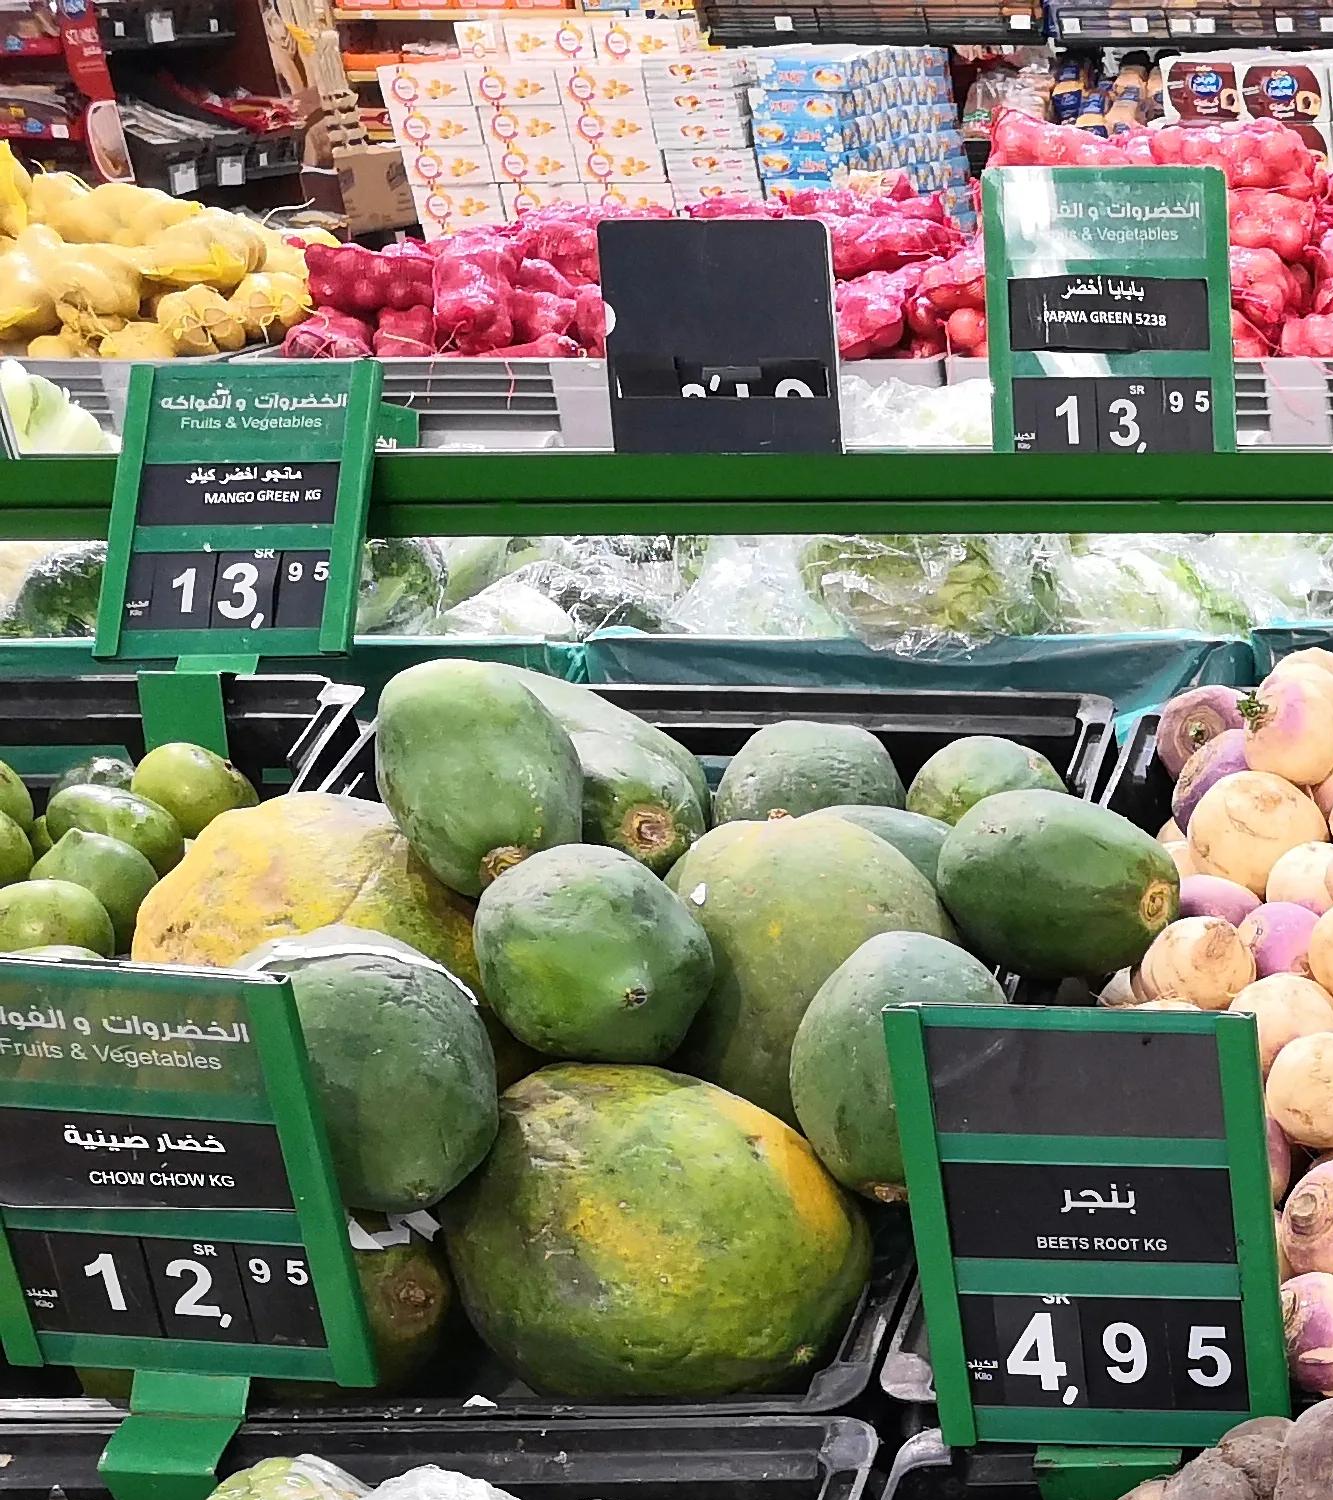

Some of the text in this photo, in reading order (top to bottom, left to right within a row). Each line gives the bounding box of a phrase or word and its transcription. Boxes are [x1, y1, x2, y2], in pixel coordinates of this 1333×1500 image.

[1082, 227, 1093, 240] &
[1096, 227, 1179, 243] Vegetables
[1044, 310, 1167, 327] PAPAYA GREEN 5238
[1129, 384, 1145, 395] SR
[254, 393, 348, 411] الخضروات
[180, 415, 322, 432] Fruits & Vegetables
[185, 467, 216, 484] كيلو
[204, 489, 321, 504] MANGO GREEN KG
[254, 548, 275, 559] SR
[0, 1005, 250, 1043] الخضروات و الفوا
[0, 1037, 223, 1071] Fruits & Vegetables
[63, 1124, 227, 1154] خضار صينية
[89, 1170, 235, 1188] CHOW CHOW KG
[1060, 1182, 1138, 1215] بنجر
[192, 1243, 218, 1257] SR
[1036, 1236, 1168, 1252] BEETS ROOT KG
[974, 1371, 993, 1381] Kilo
